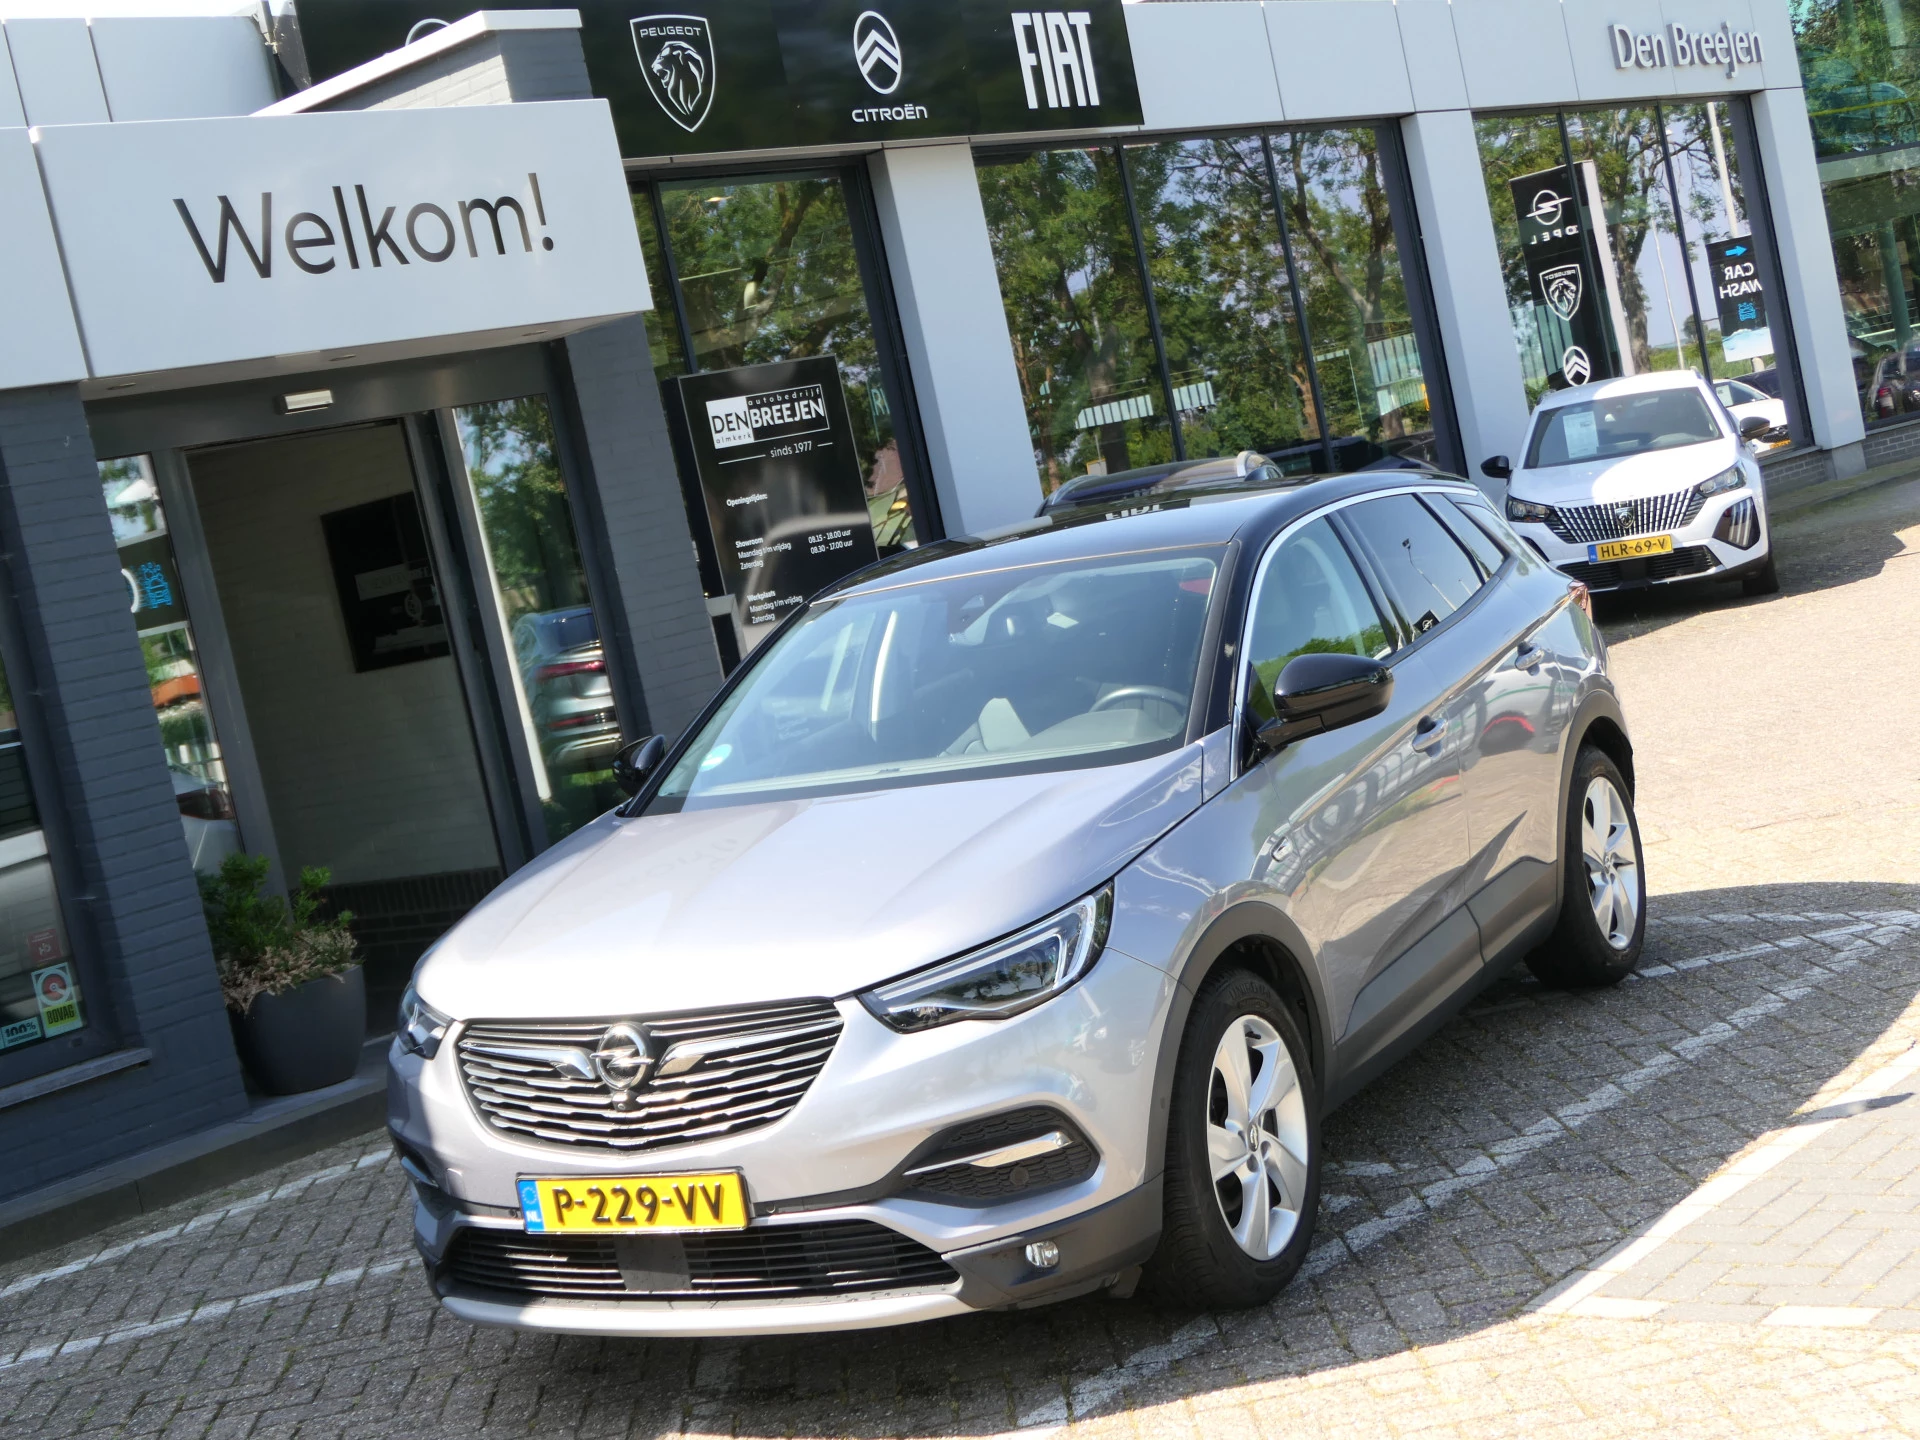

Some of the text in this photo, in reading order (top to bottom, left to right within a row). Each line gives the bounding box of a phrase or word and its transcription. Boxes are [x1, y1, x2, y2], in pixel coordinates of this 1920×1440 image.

[639, 26, 702, 39] PEUGEOT
[1607, 20, 1765, 80] Den Breejen
[1010, 11, 1101, 110] FIAT
[851, 104, 928, 124] CITROËN
[171, 172, 555, 284] Welkom!
[747, 387, 820, 406] autobedrijf
[711, 398, 825, 434] DEN BREEJEN
[770, 441, 813, 458] sinds 1977
[735, 537, 764, 548] Showroom
[1600, 538, 1666, 558] HLR-69-V
[740, 560, 764, 570] Zaterdag
[746, 590, 776, 602] Werkplaats
[750, 602, 775, 613] Maandag
[752, 613, 776, 624] Zaterdag
[46, 1004, 75, 1025] BOVAG
[5, 1022, 37, 1038] 100%
[551, 1182, 724, 1225] P-229-VV
[526, 1210, 541, 1223] NL
